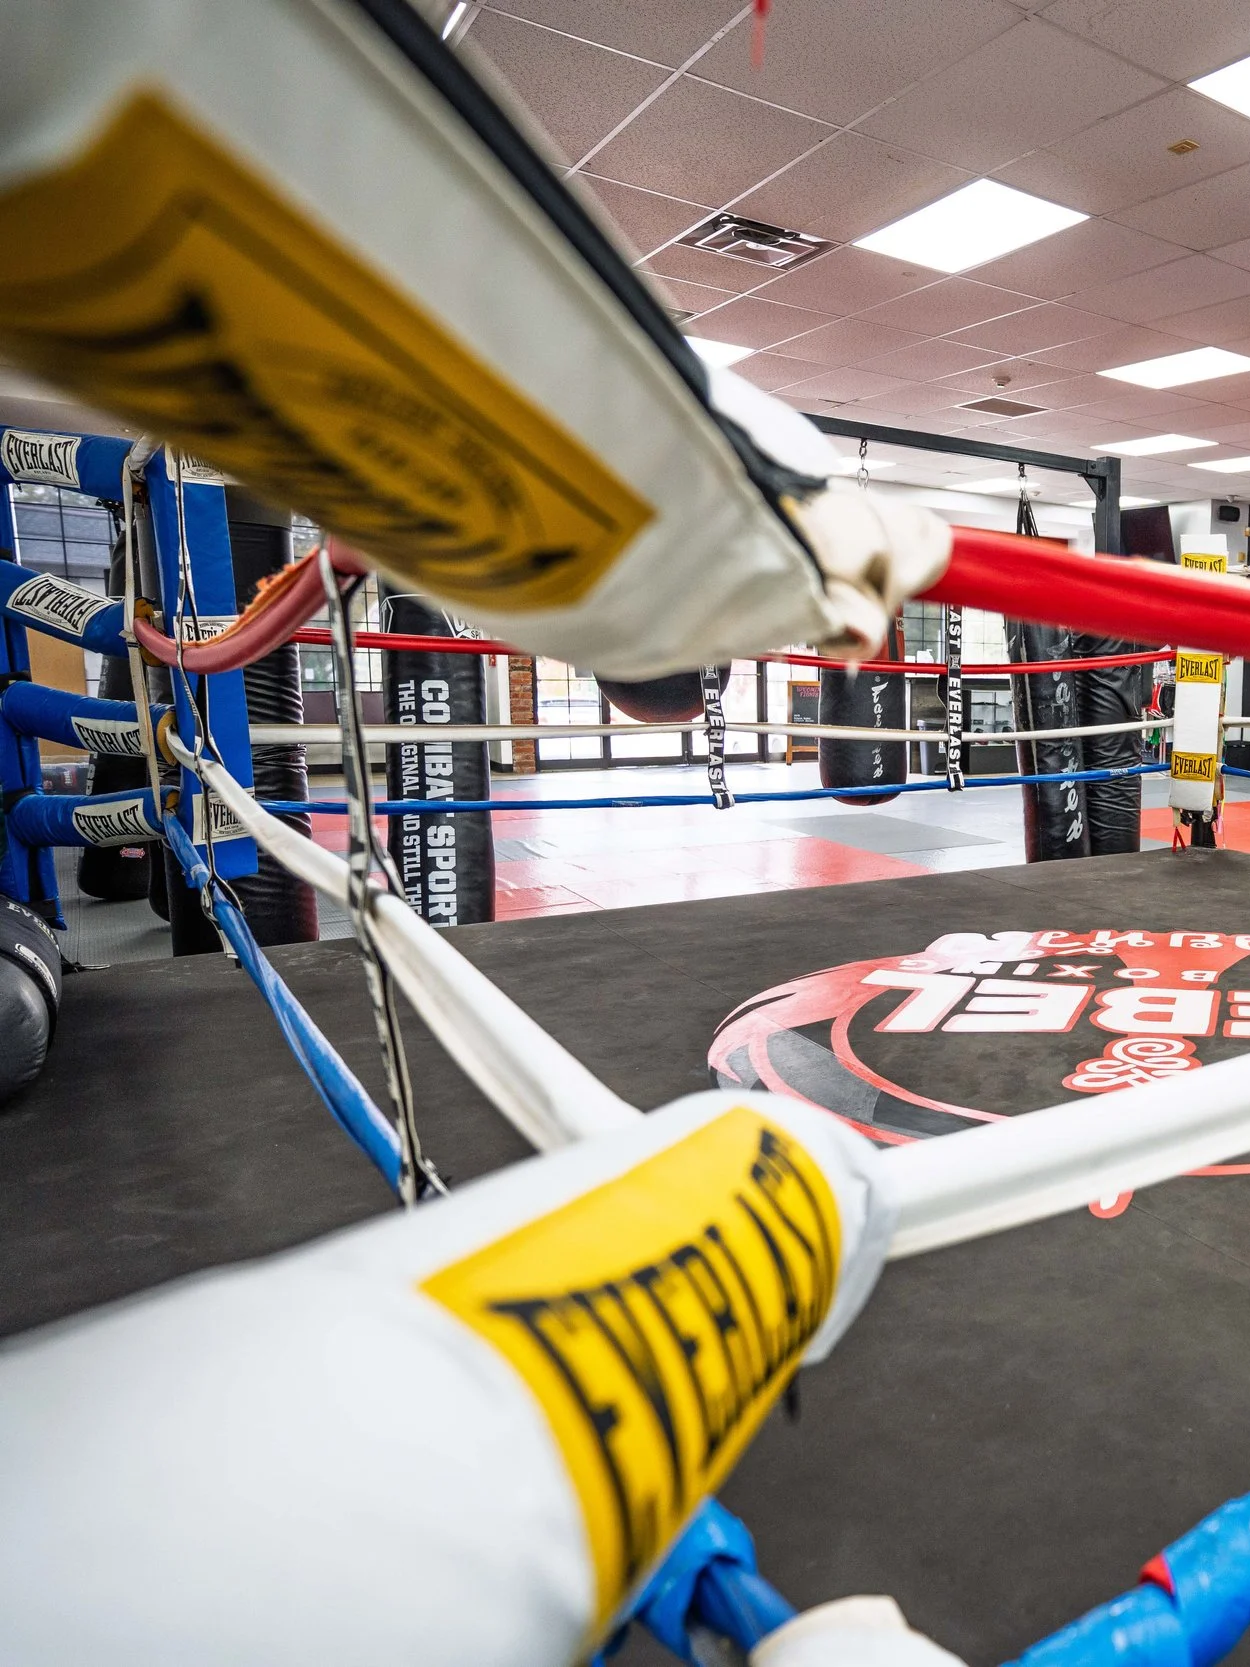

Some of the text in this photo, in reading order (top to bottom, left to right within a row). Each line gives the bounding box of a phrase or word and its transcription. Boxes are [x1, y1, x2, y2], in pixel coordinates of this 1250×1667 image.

[7, 434, 74, 480] EVERLAST
[15, 579, 104, 631] EVERLAST
[1179, 656, 1220, 681] EVERLAST
[399, 680, 415, 711] THE
[75, 722, 147, 756] EVERLAST
[704, 688, 727, 794] EVERLAST
[949, 677, 962, 774] EVERLAST
[400, 715, 418, 795] OGINAL
[421, 680, 454, 818] COBA
[1173, 754, 1213, 778] EVERLAST
[75, 804, 154, 844] EVERLAST
[403, 798, 421, 831] ND
[403, 836, 421, 881] STILL
[899, 959, 1208, 984] BOXING
